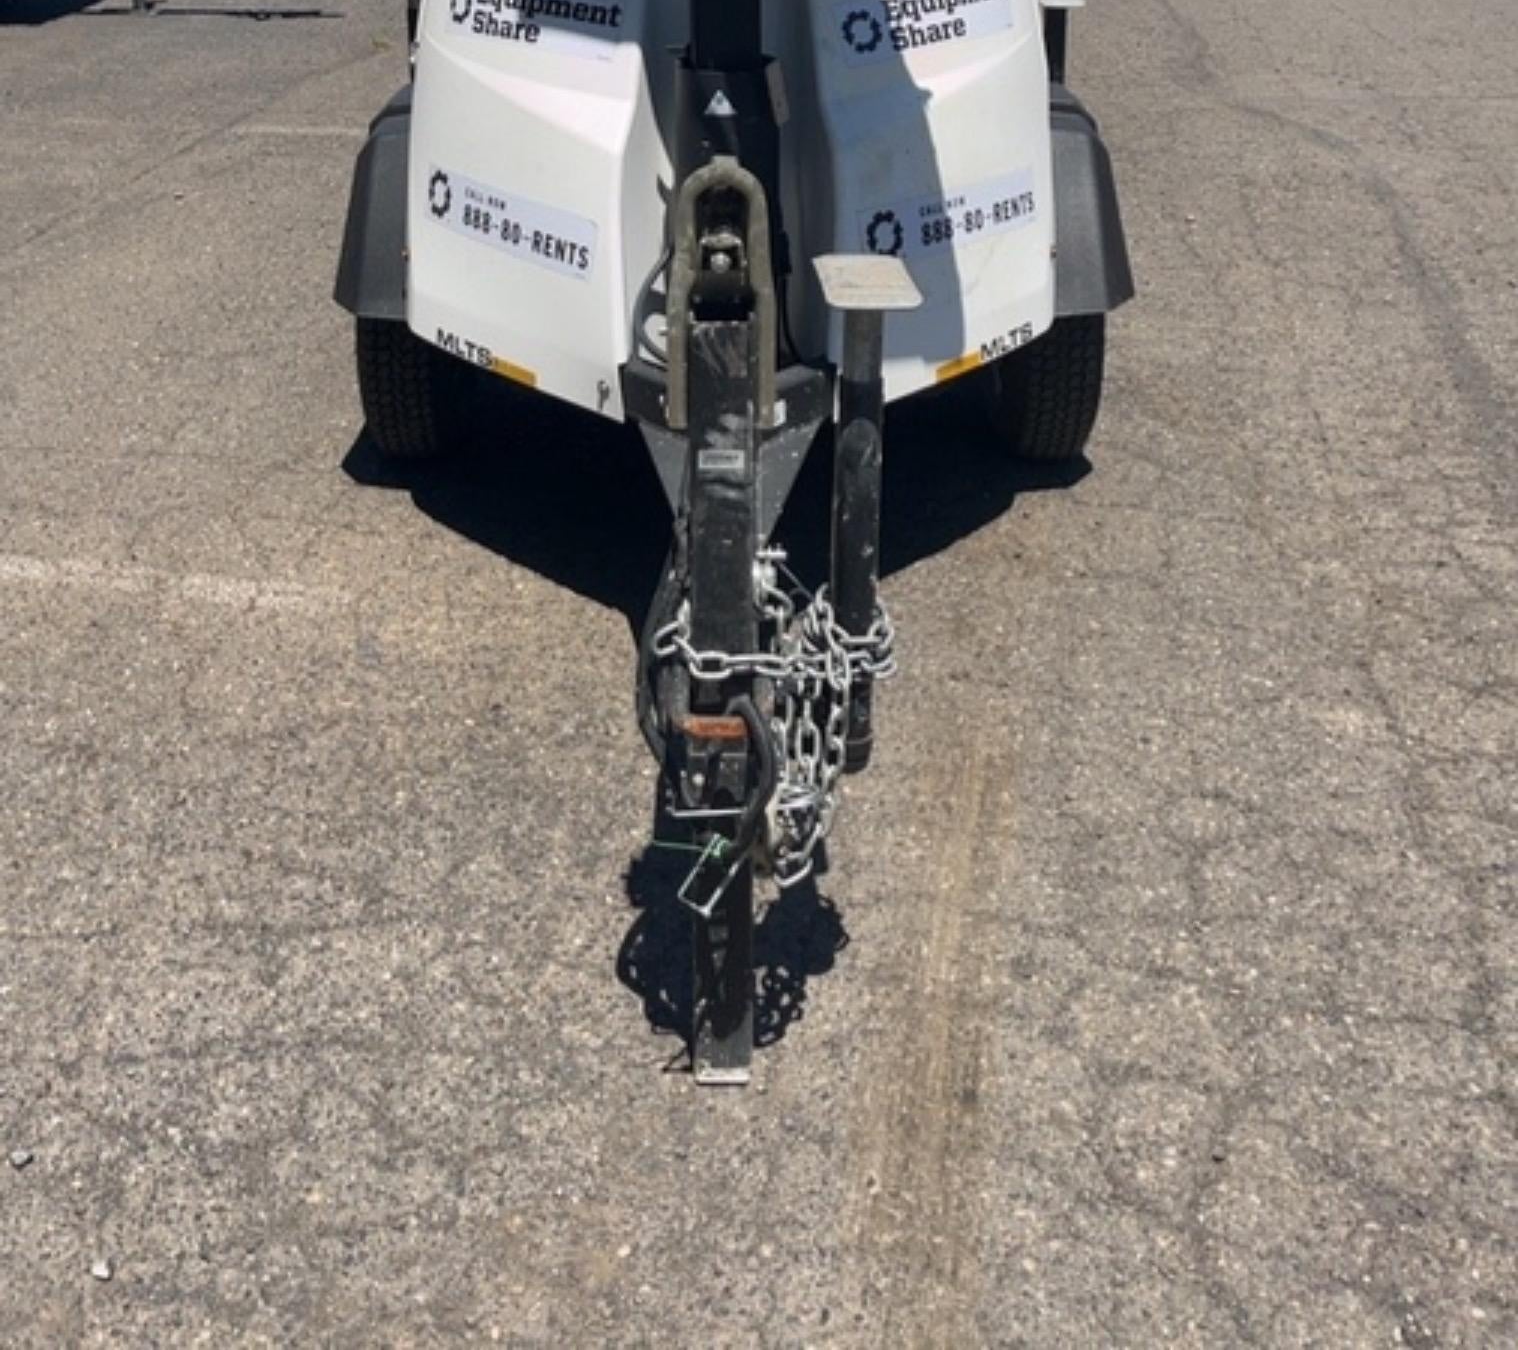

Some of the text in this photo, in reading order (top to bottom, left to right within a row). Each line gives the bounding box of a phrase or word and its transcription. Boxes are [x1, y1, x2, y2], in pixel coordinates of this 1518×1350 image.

[472, 10, 541, 43] Share
[889, 16, 967, 52] Share
[464, 204, 589, 270] 888-80-RENTS
[922, 191, 1035, 246] 888-80-RENTS
[437, 328, 493, 367] MLTS
[981, 321, 1034, 361] MLTS
